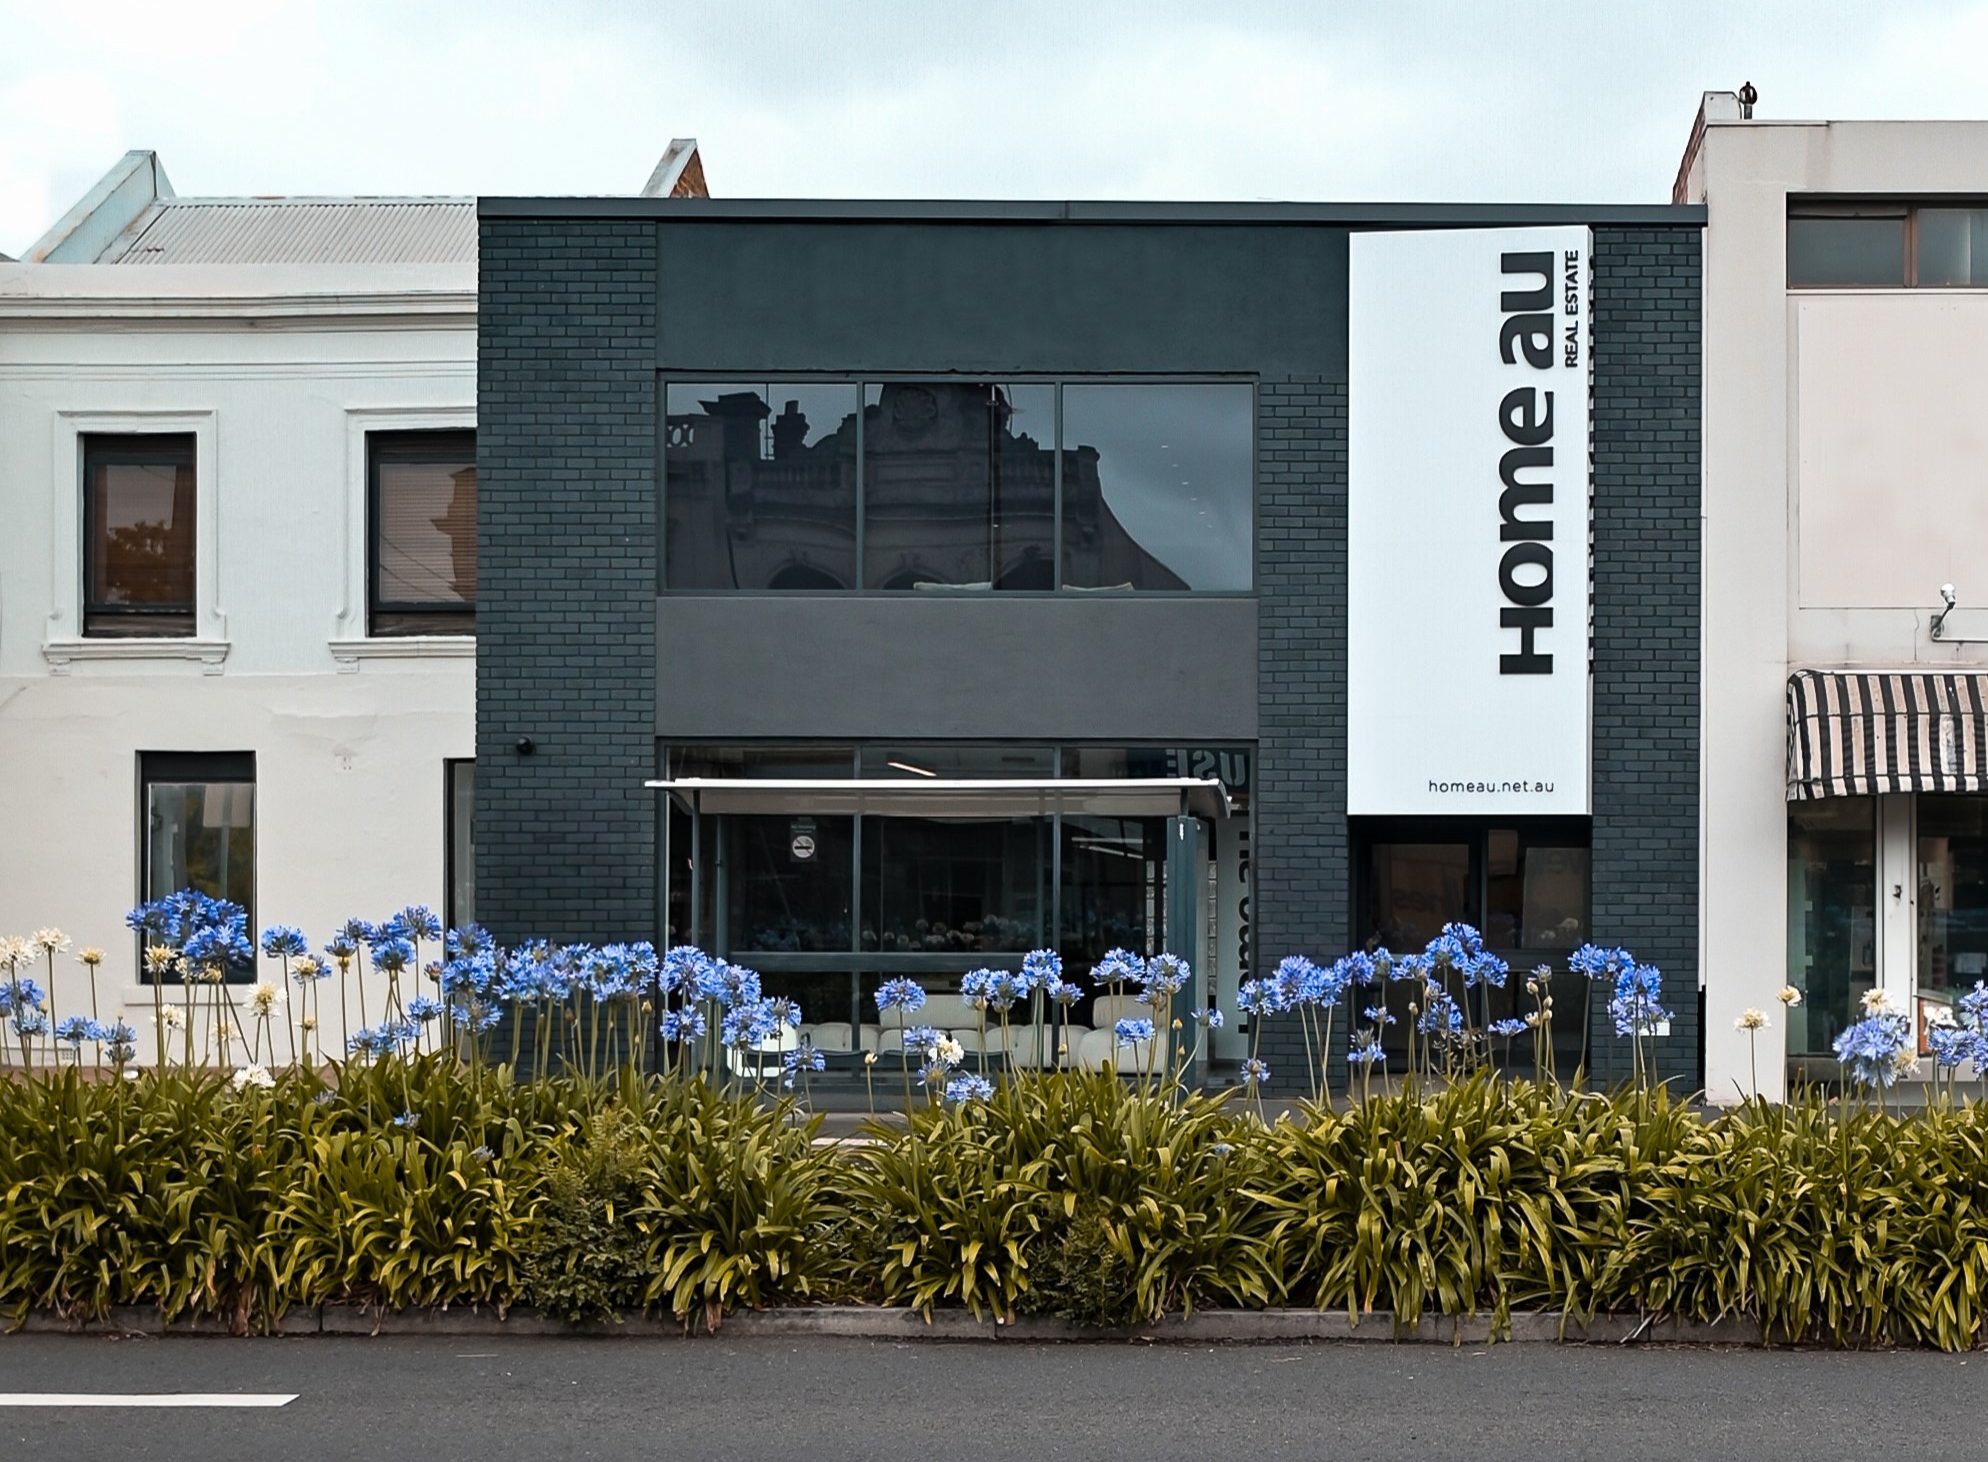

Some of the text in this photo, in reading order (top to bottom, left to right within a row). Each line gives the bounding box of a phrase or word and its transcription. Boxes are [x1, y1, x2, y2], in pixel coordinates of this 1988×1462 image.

[1565, 250, 1579, 368] REAL ESTATE
[1498, 251, 1554, 675] Home au
[1428, 779, 1555, 793] homeau.net.au
